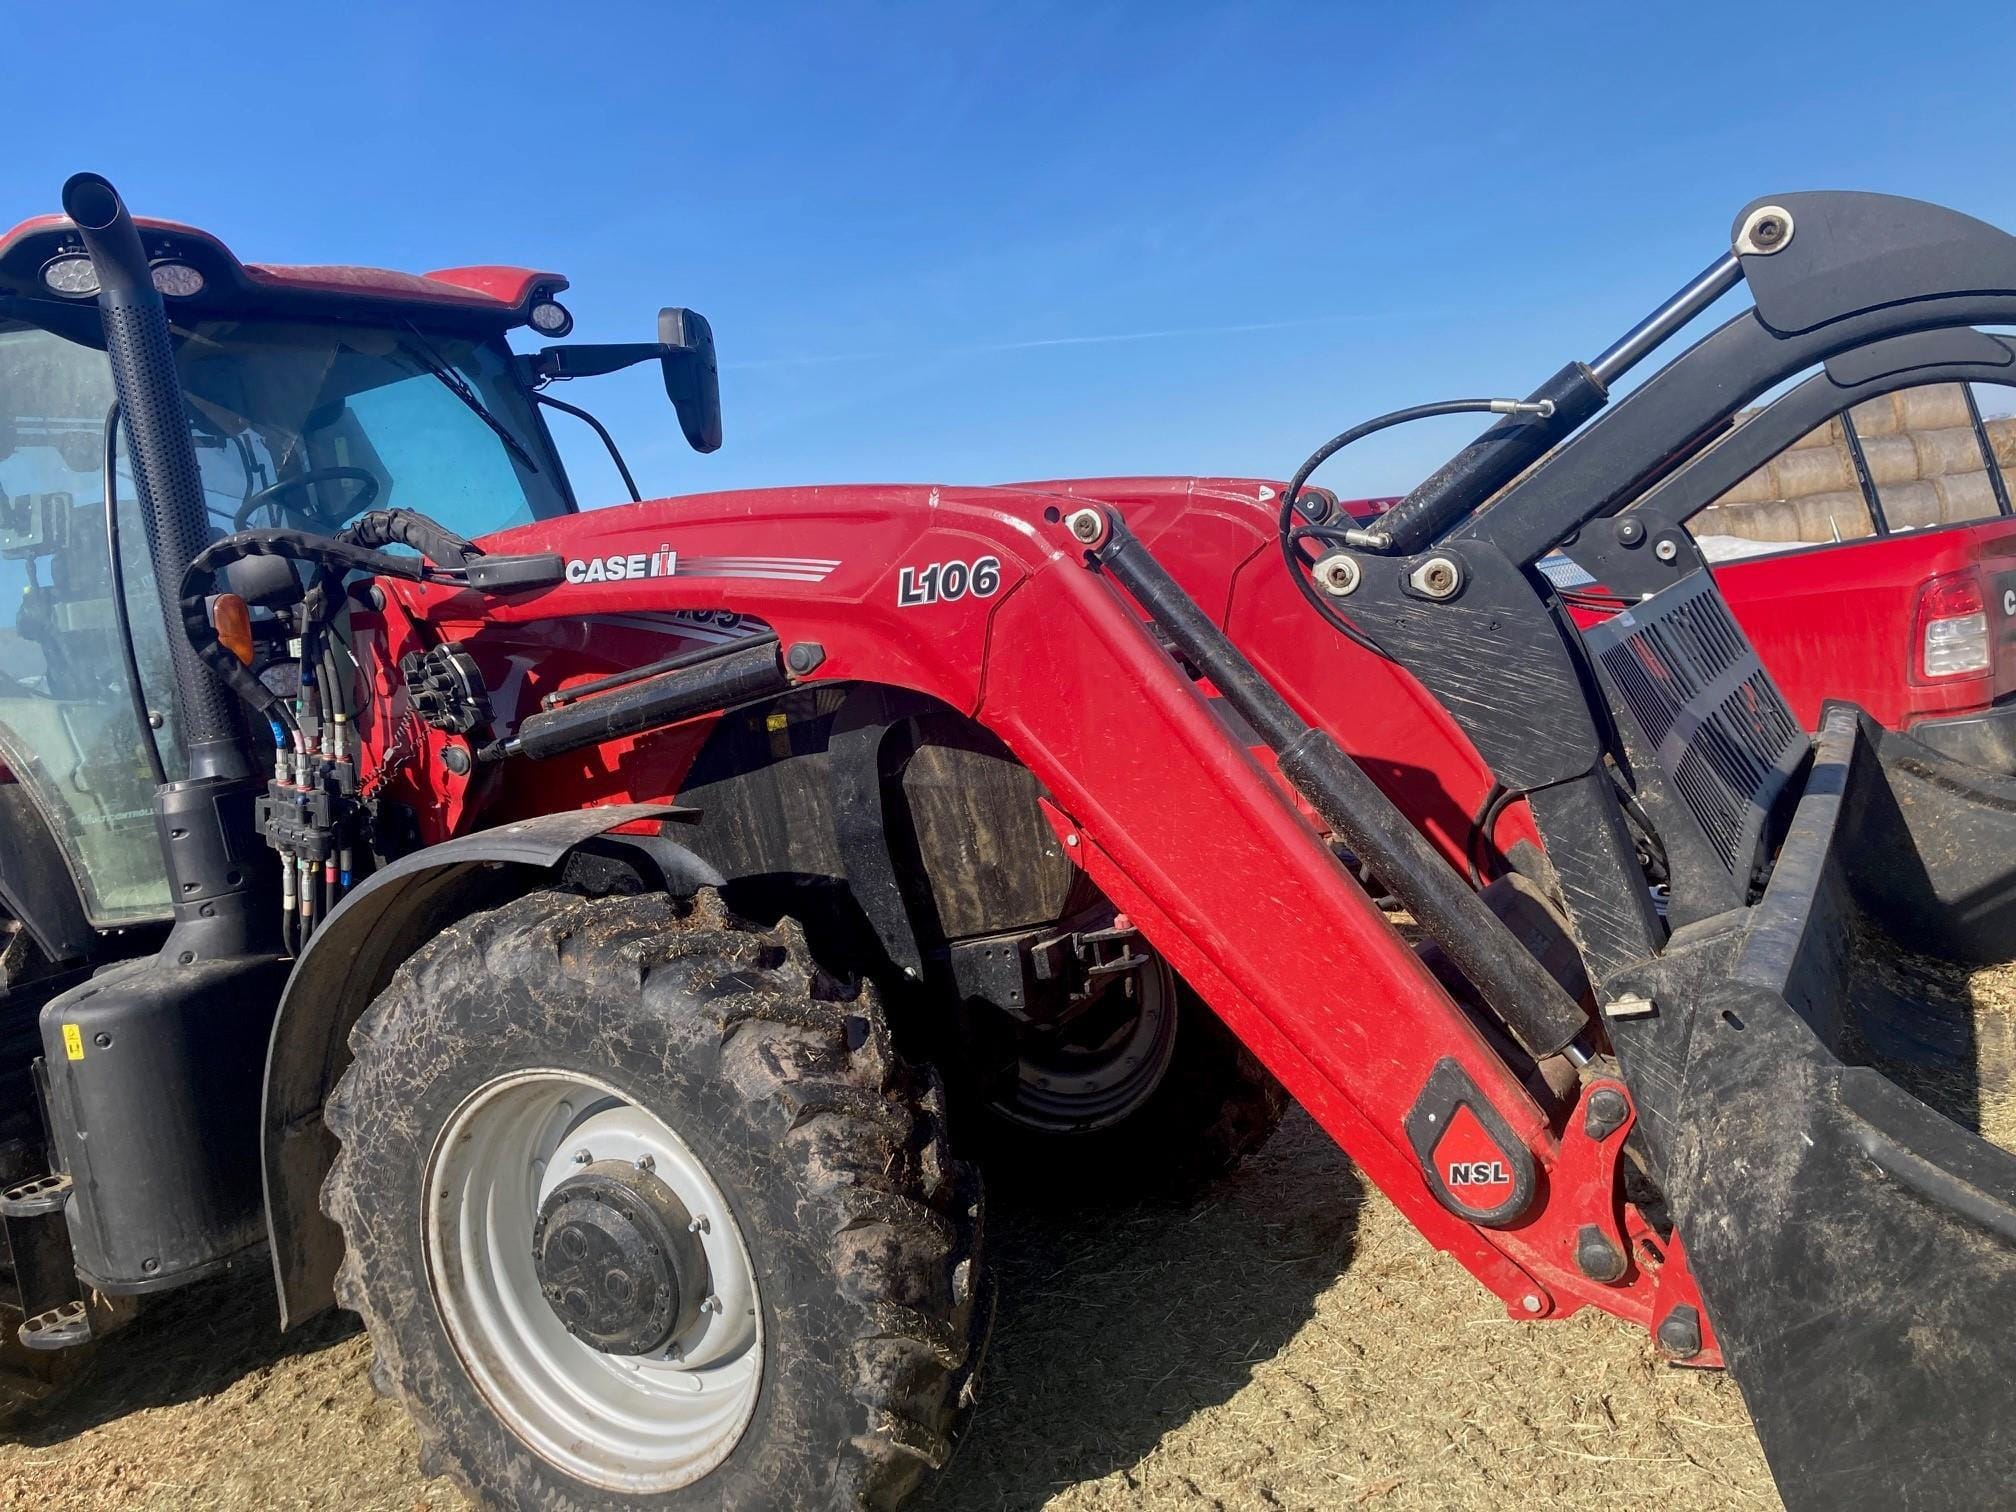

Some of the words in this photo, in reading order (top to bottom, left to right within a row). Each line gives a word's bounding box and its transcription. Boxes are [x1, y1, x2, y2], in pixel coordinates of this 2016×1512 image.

[565, 554, 647, 584] CASE
[898, 555, 1001, 607] L106
[1450, 1161, 1509, 1185] NSL
